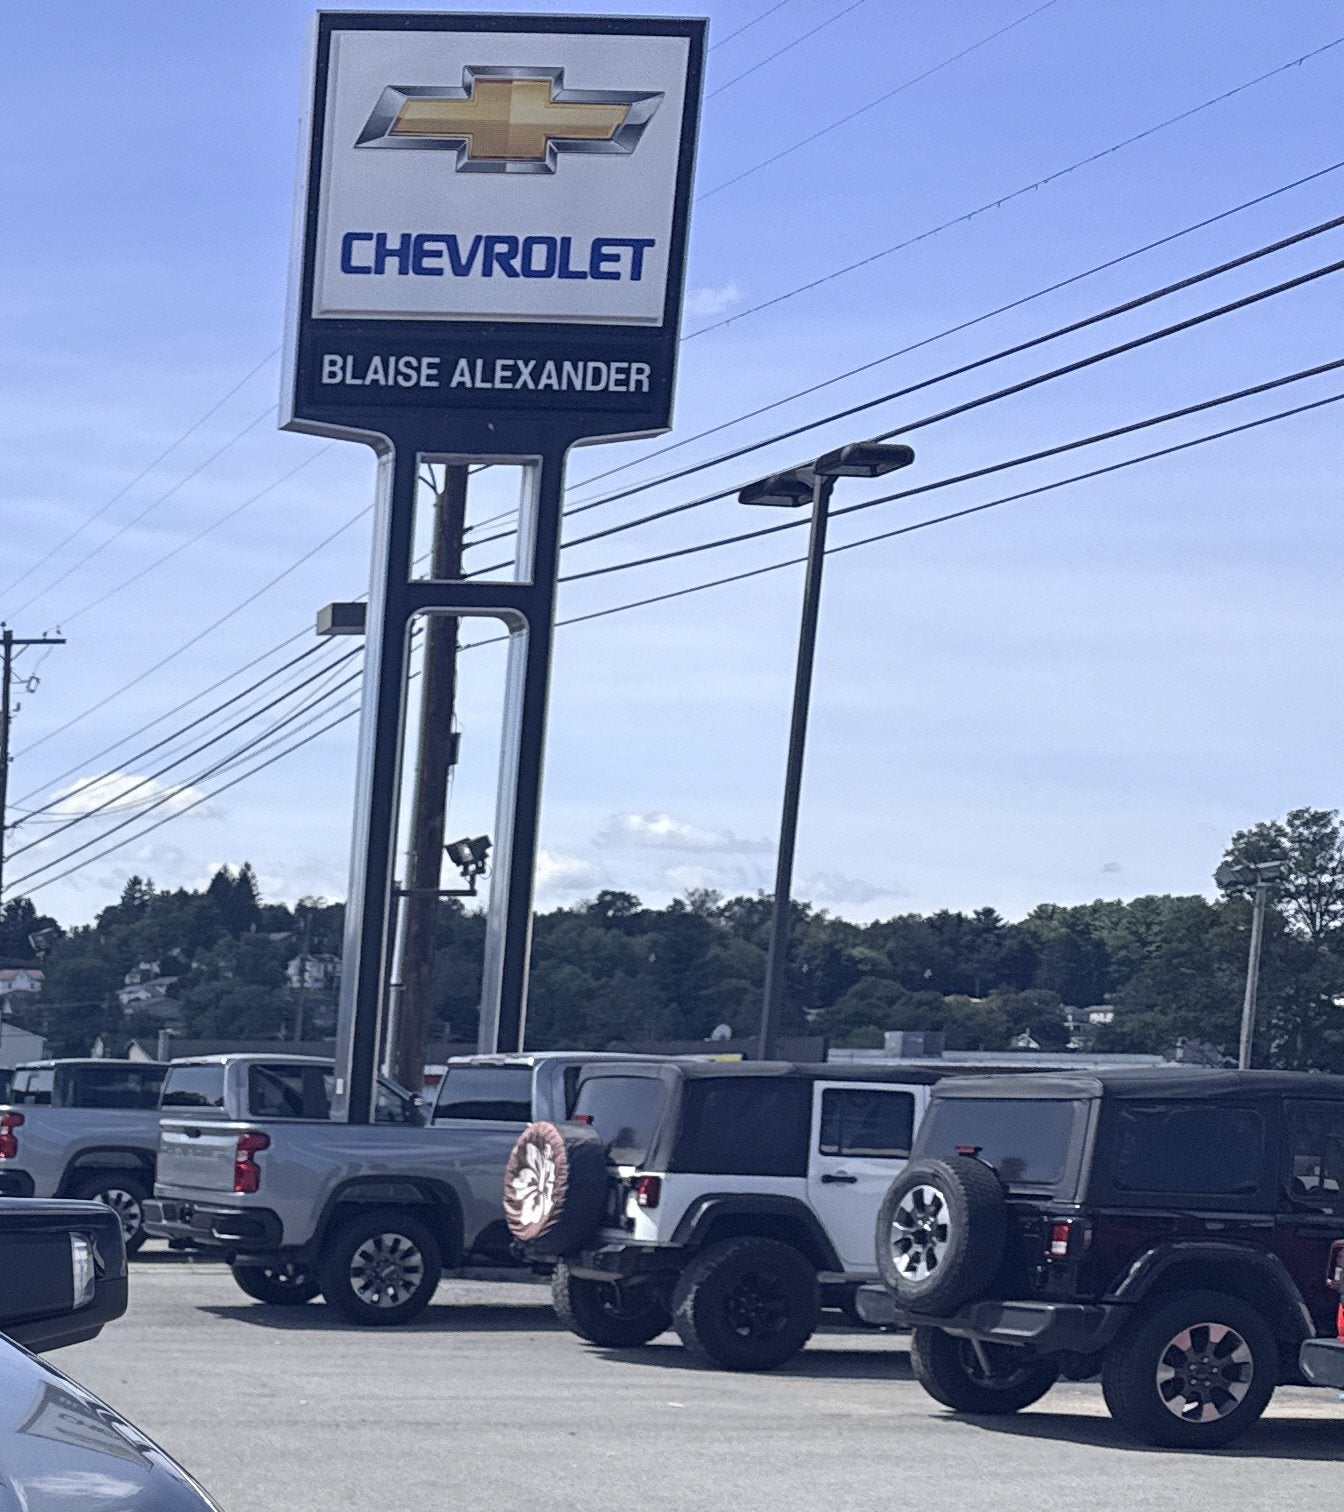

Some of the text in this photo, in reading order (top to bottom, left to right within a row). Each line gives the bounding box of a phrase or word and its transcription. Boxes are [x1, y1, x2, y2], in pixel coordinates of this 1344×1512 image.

[340, 231, 656, 281] CHEVROLET
[321, 353, 651, 393] BLAISE ALEXANDER
